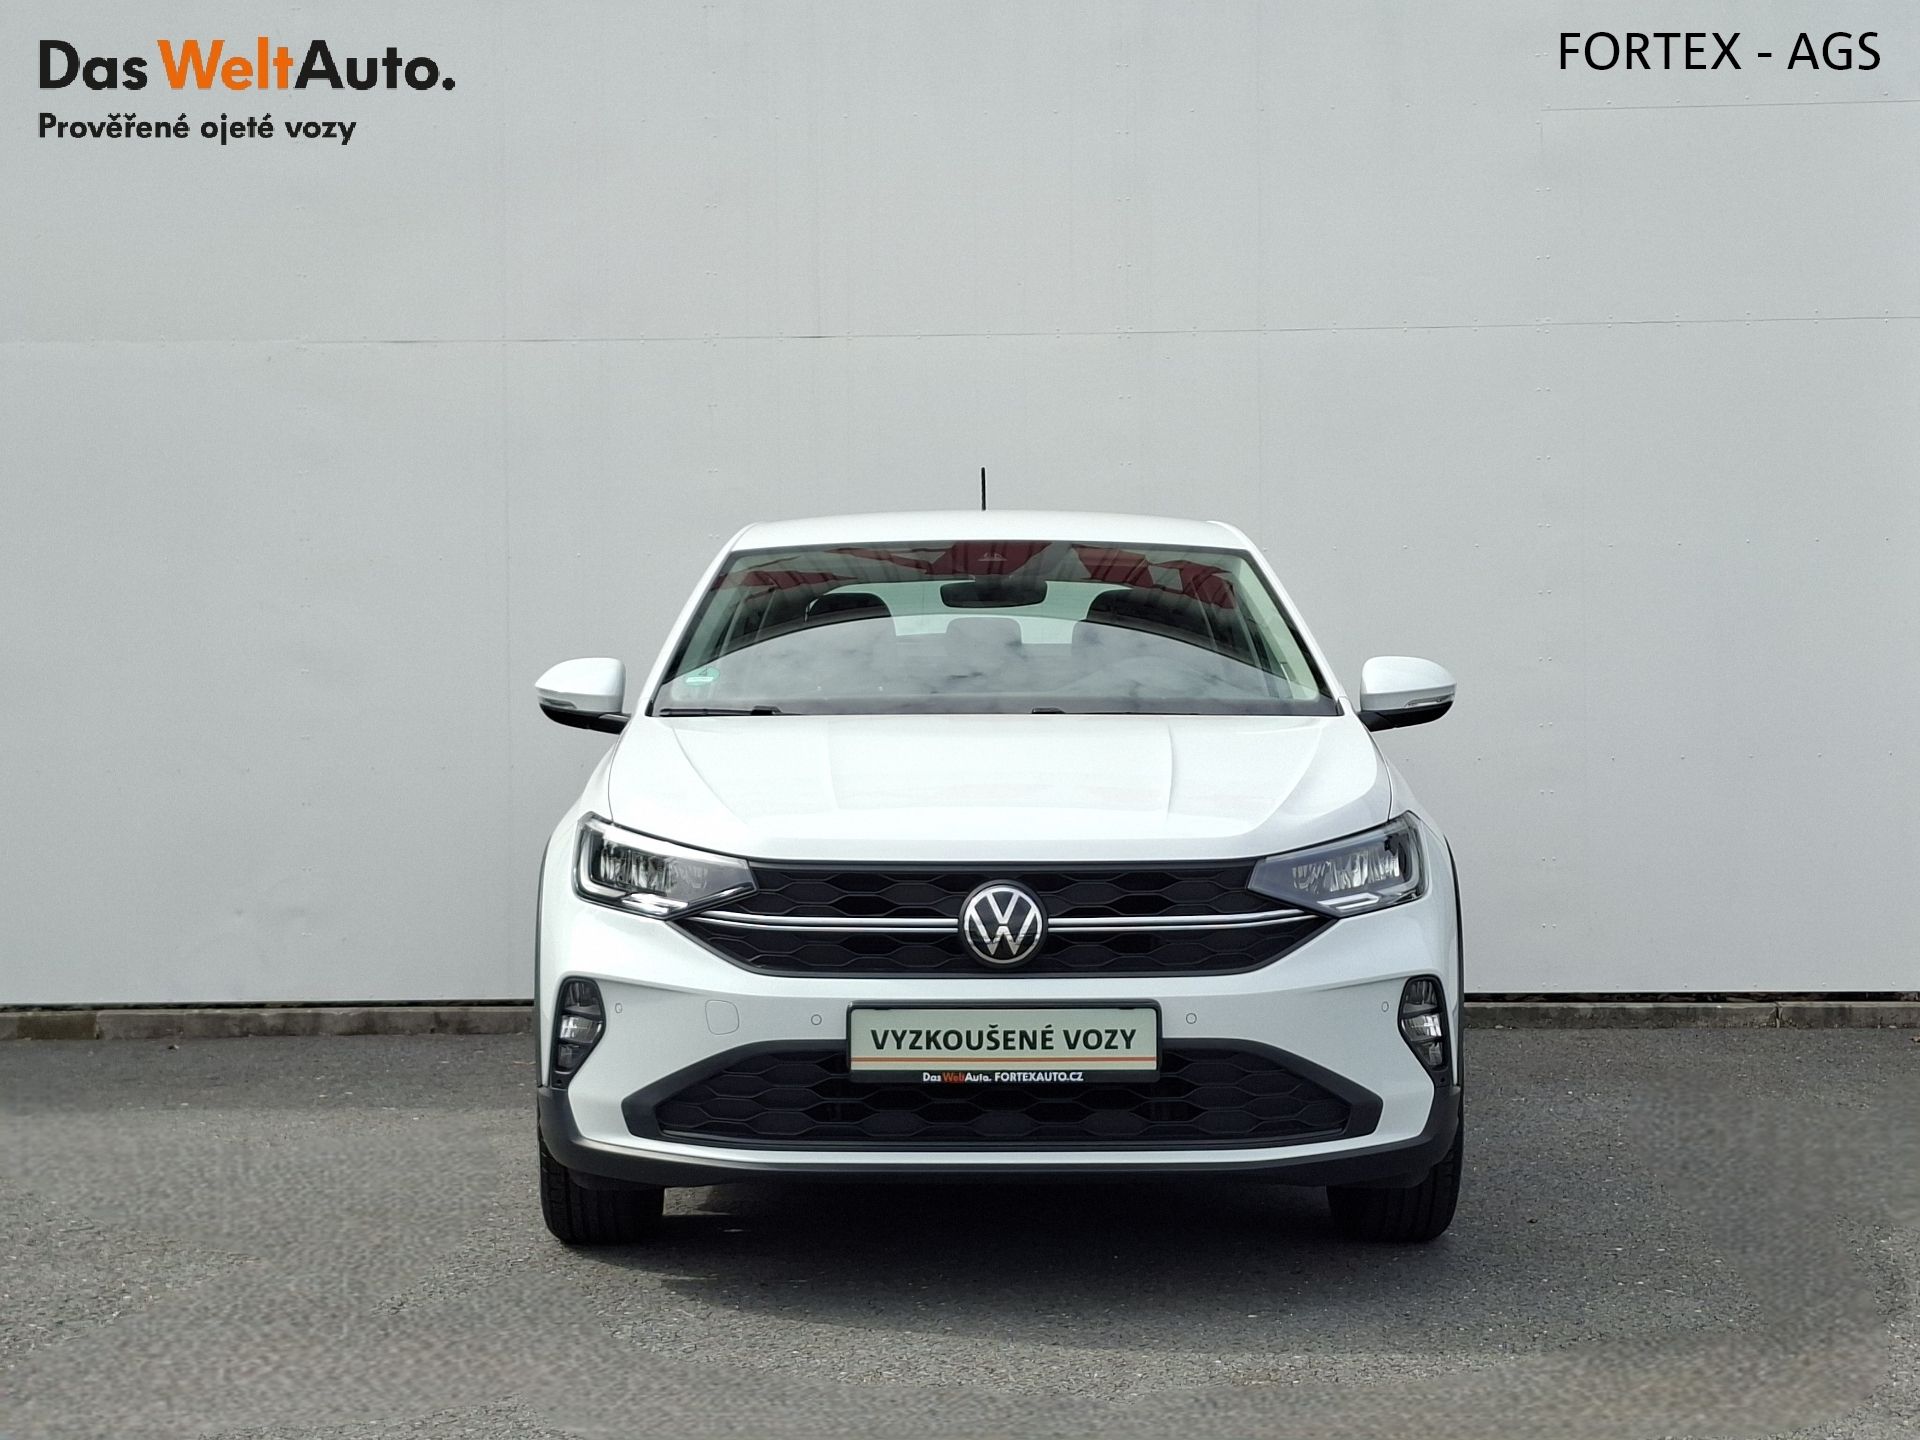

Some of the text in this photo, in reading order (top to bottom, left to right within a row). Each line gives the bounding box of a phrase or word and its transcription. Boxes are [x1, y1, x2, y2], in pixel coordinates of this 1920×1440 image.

[870, 1023, 1137, 1051] VYZKOUŠENÉ VOZY
[922, 1072, 942, 1082] Das
[994, 1072, 1084, 1082] FORTEXAUTO.CZ
